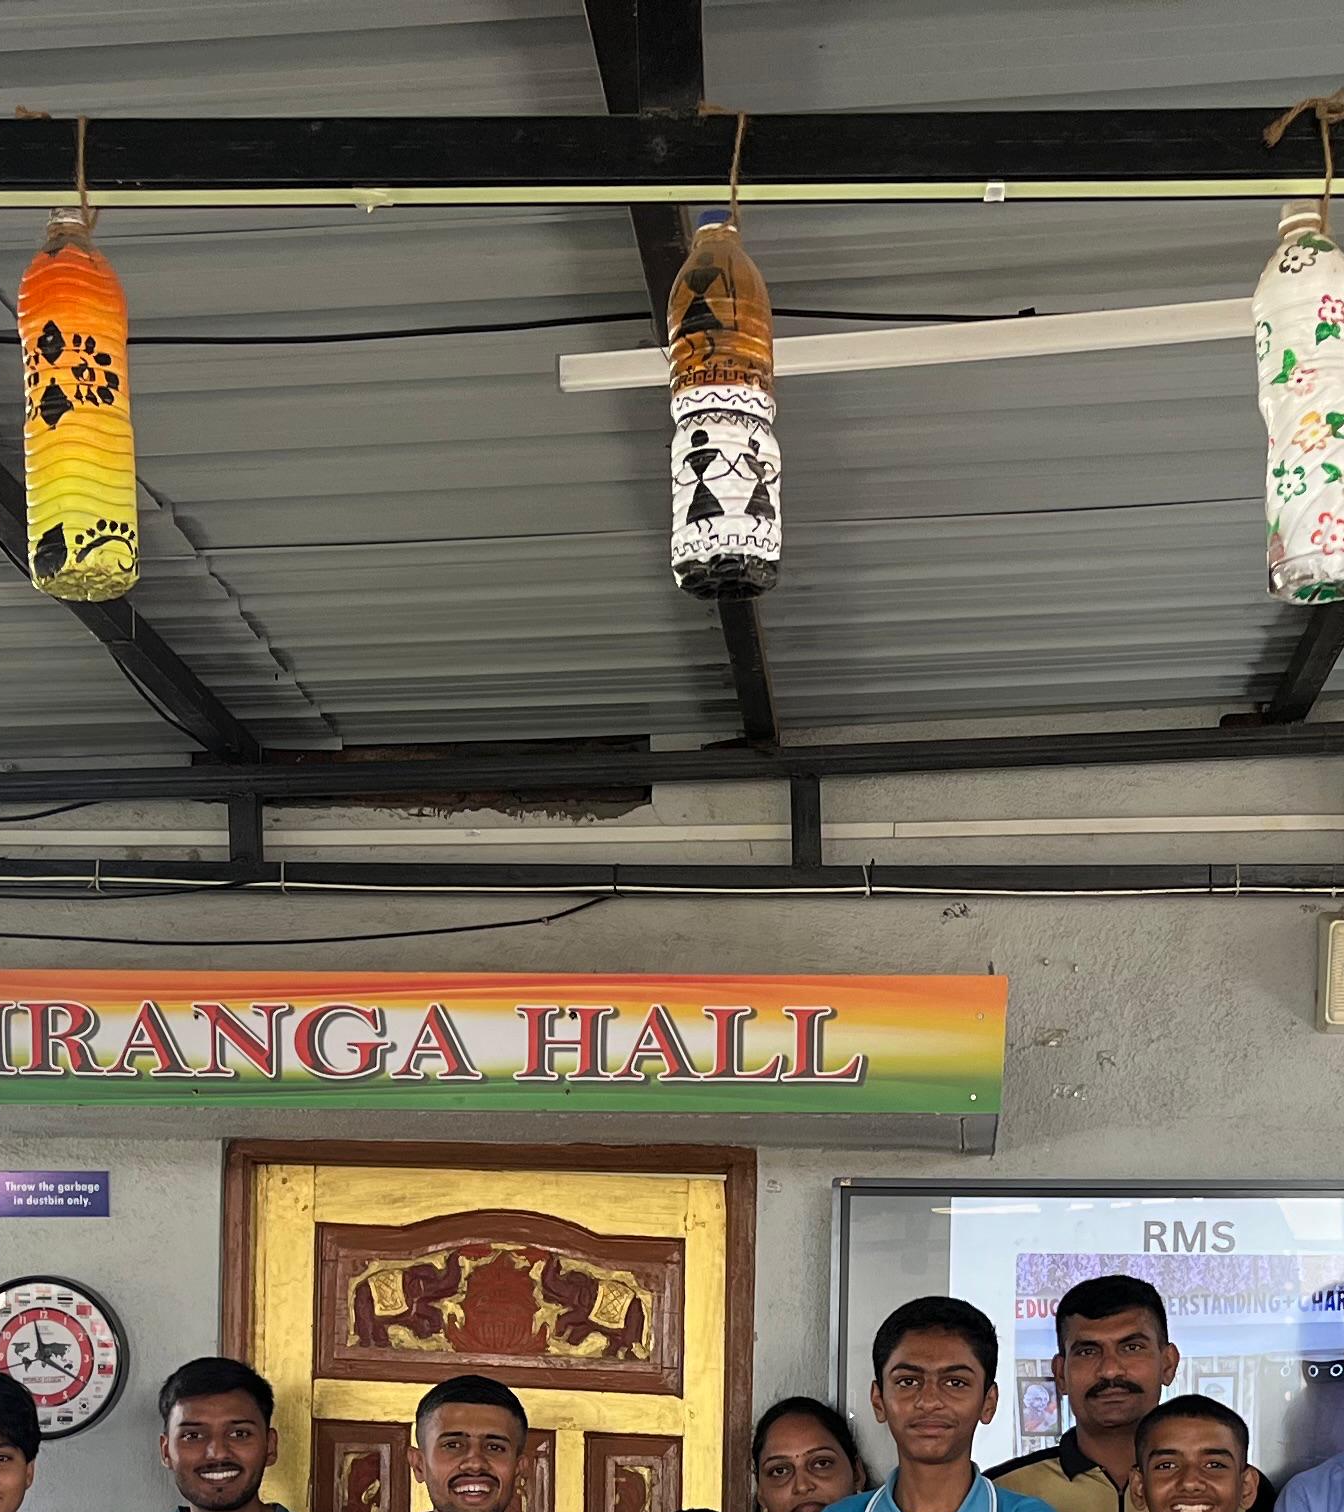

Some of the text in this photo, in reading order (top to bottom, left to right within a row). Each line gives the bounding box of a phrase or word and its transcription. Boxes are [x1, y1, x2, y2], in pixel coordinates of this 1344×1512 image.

[513, 1003, 866, 1083] HALL
[5, 1181, 100, 1193] Throw the garbage
[13, 1195, 92, 1207] in dustbin only.
[1142, 1220, 1237, 1253] RMS
